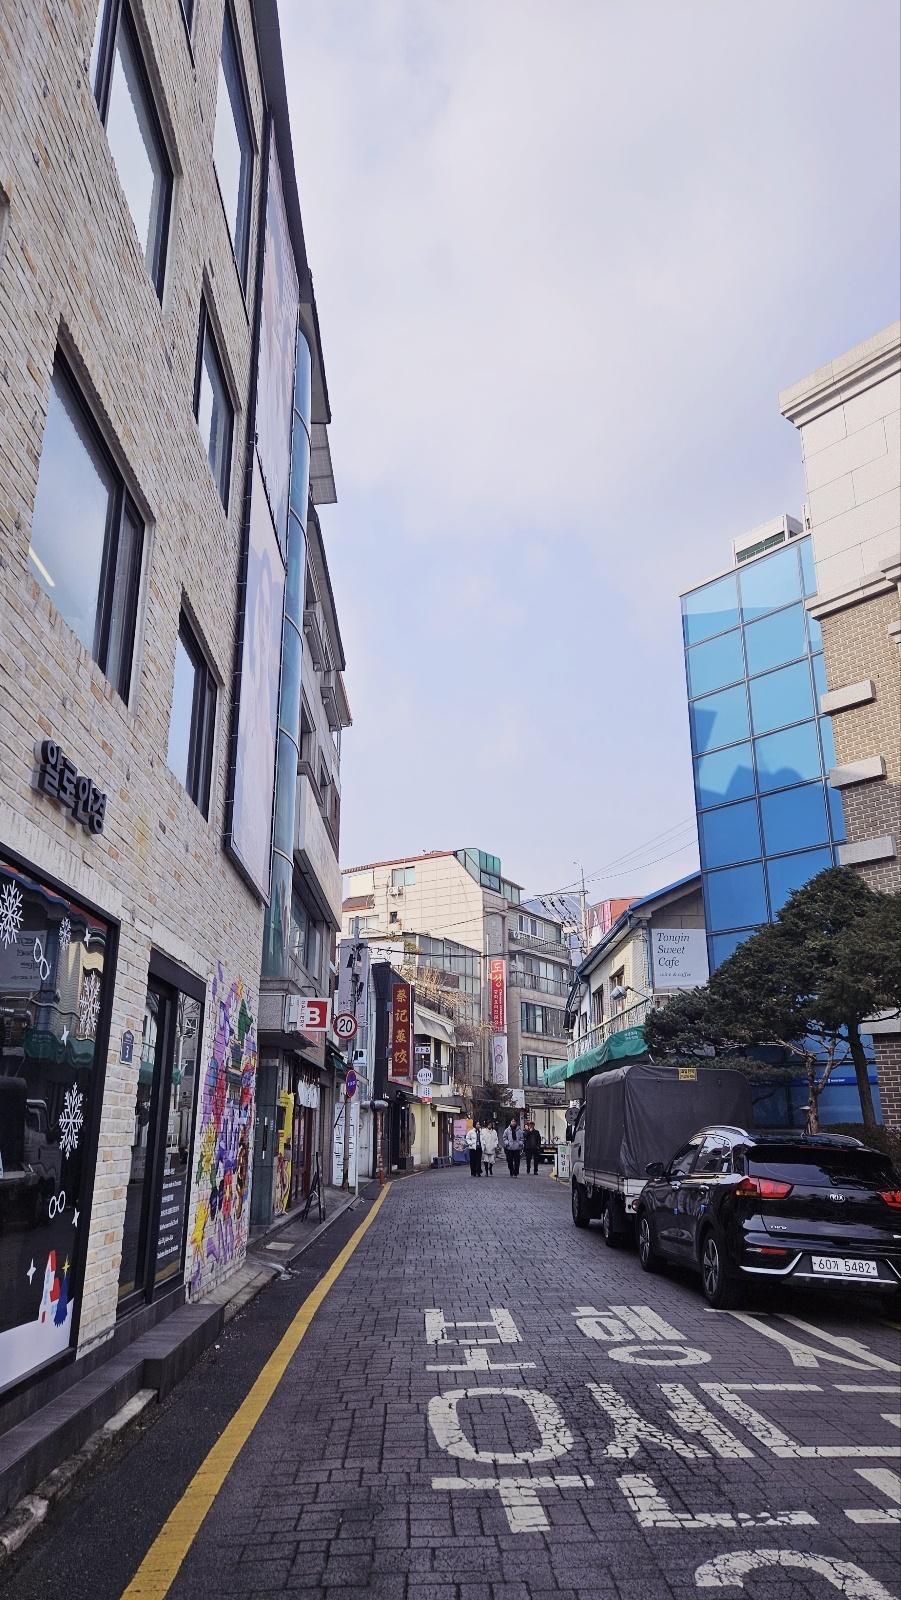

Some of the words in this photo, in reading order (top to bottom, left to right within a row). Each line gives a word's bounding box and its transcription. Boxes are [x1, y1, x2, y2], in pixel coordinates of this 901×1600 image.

[657, 932, 690, 944] Tongin
[657, 945, 685, 954] Sweet
[658, 956, 680, 968] Cafe
[306, 1006, 321, 1025] B
[339, 1018, 353, 1033] 20
[844, 1260, 871, 1274] 5482
